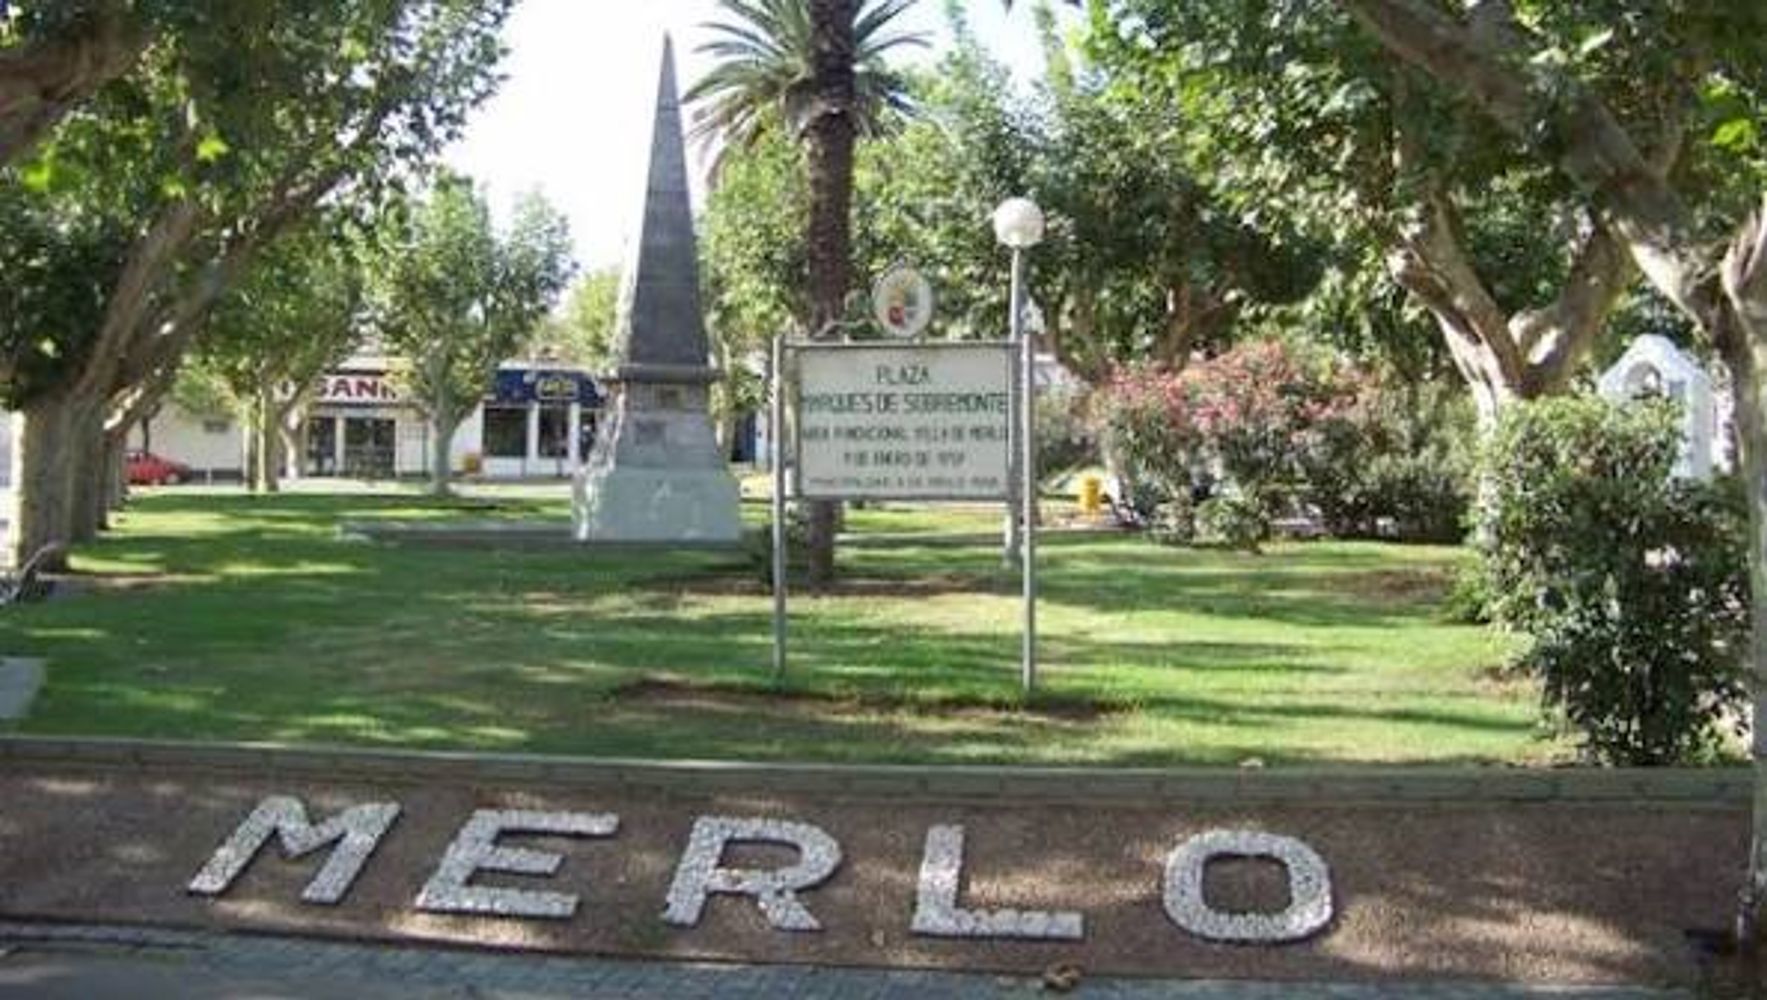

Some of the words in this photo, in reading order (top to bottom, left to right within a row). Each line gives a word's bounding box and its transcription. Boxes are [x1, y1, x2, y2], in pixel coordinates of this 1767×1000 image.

[876, 364, 931, 385] PLAZA
[876, 393, 899, 414] DE
[903, 393, 1008, 414] SOBREMONTE
[187, 795, 1334, 940] MERLO
